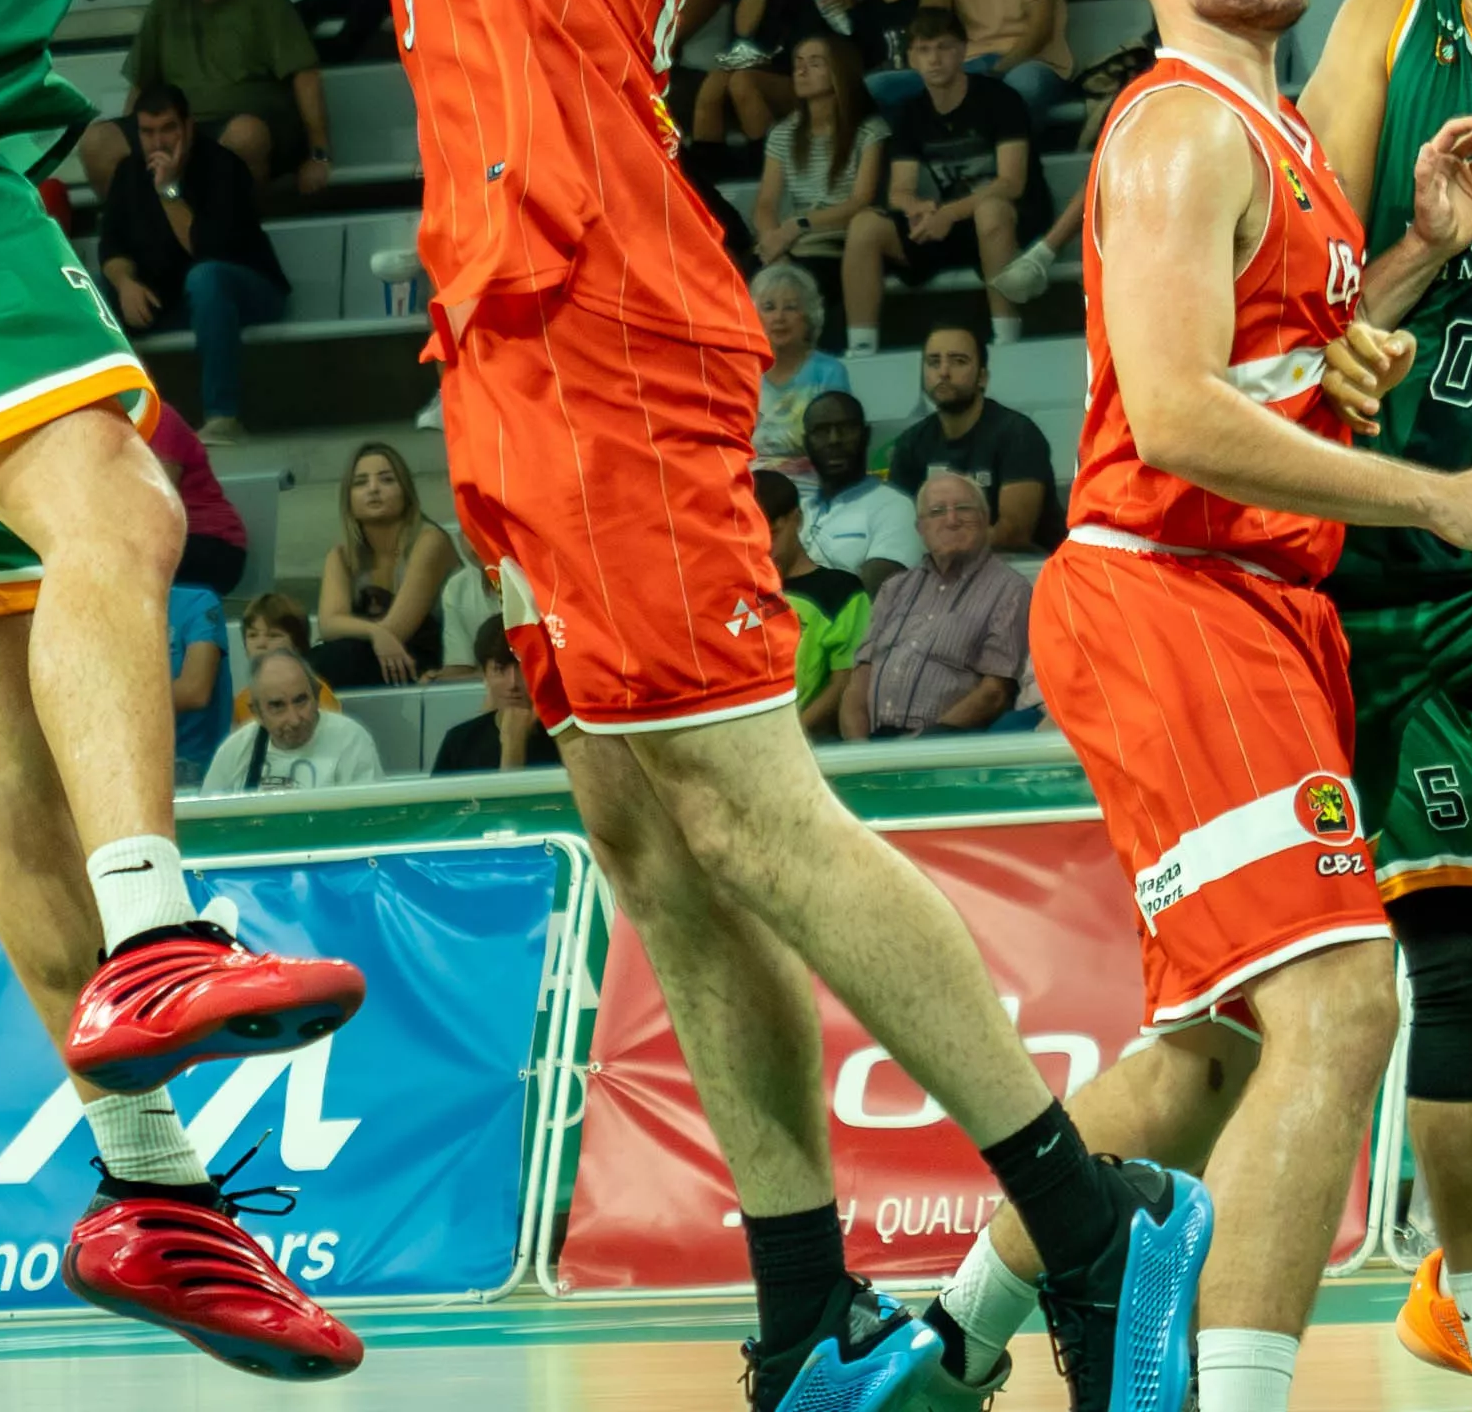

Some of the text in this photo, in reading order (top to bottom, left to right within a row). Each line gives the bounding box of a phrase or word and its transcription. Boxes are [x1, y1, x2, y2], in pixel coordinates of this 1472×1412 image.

[1413, 764, 1470, 830] 5
[1316, 853, 1367, 877] CBZ
[875, 1195, 1005, 1244] QUALIT
